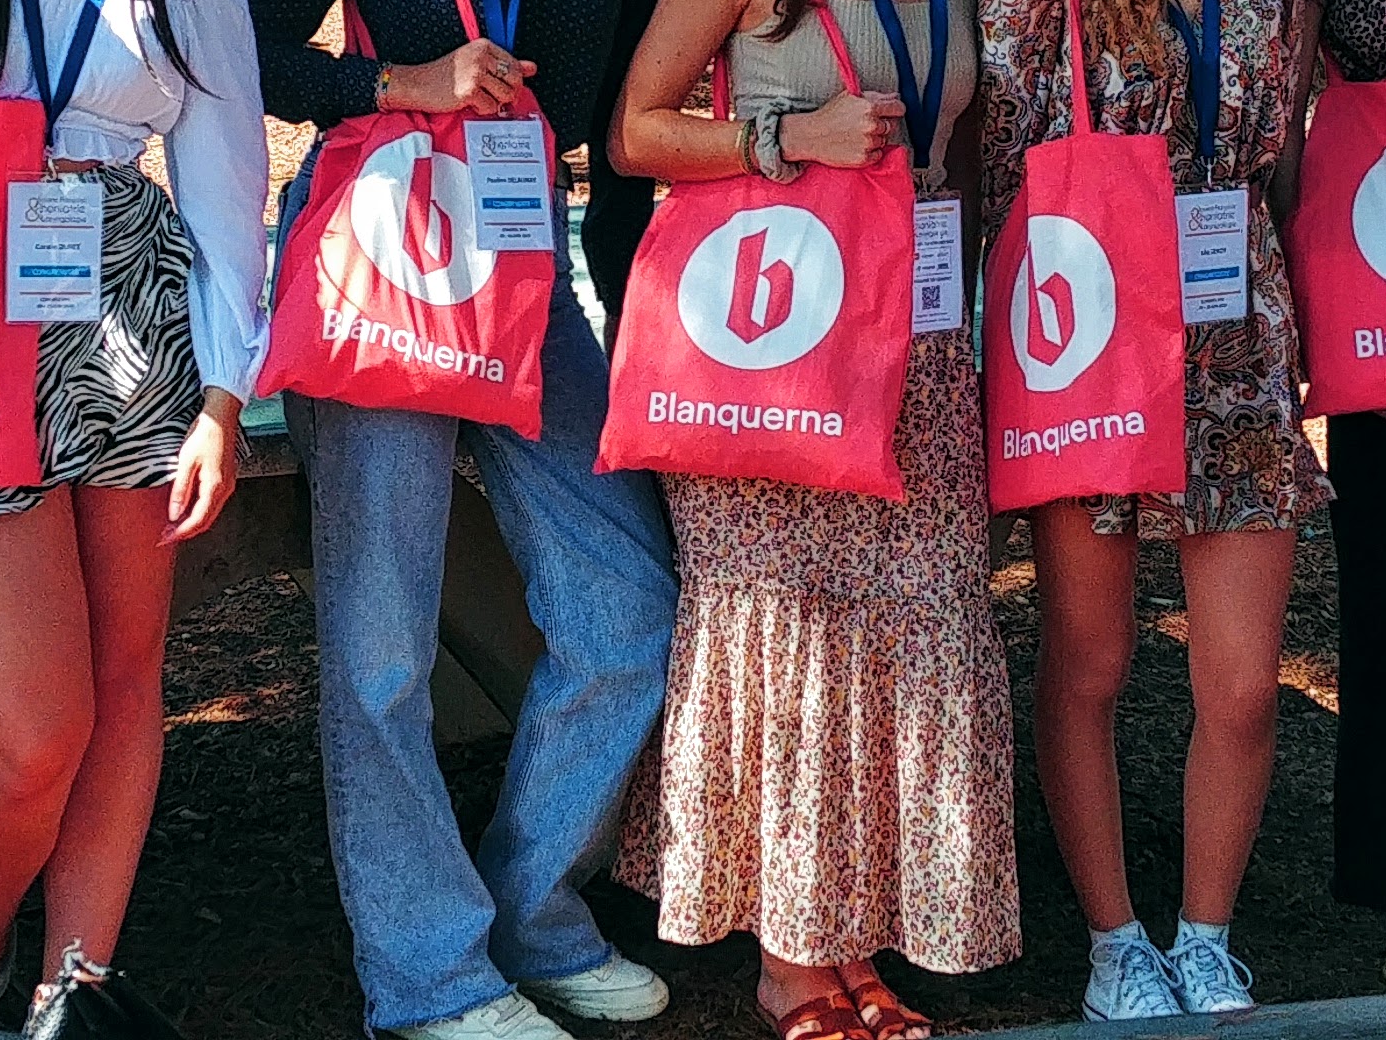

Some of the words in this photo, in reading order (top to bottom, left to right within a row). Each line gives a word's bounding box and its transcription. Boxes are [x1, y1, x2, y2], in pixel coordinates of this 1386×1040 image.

[726, 227, 795, 344] b
[322, 308, 505, 383] Blanquerna
[648, 391, 843, 437] Blanquerna
[1003, 411, 1146, 460] Blanquerna
